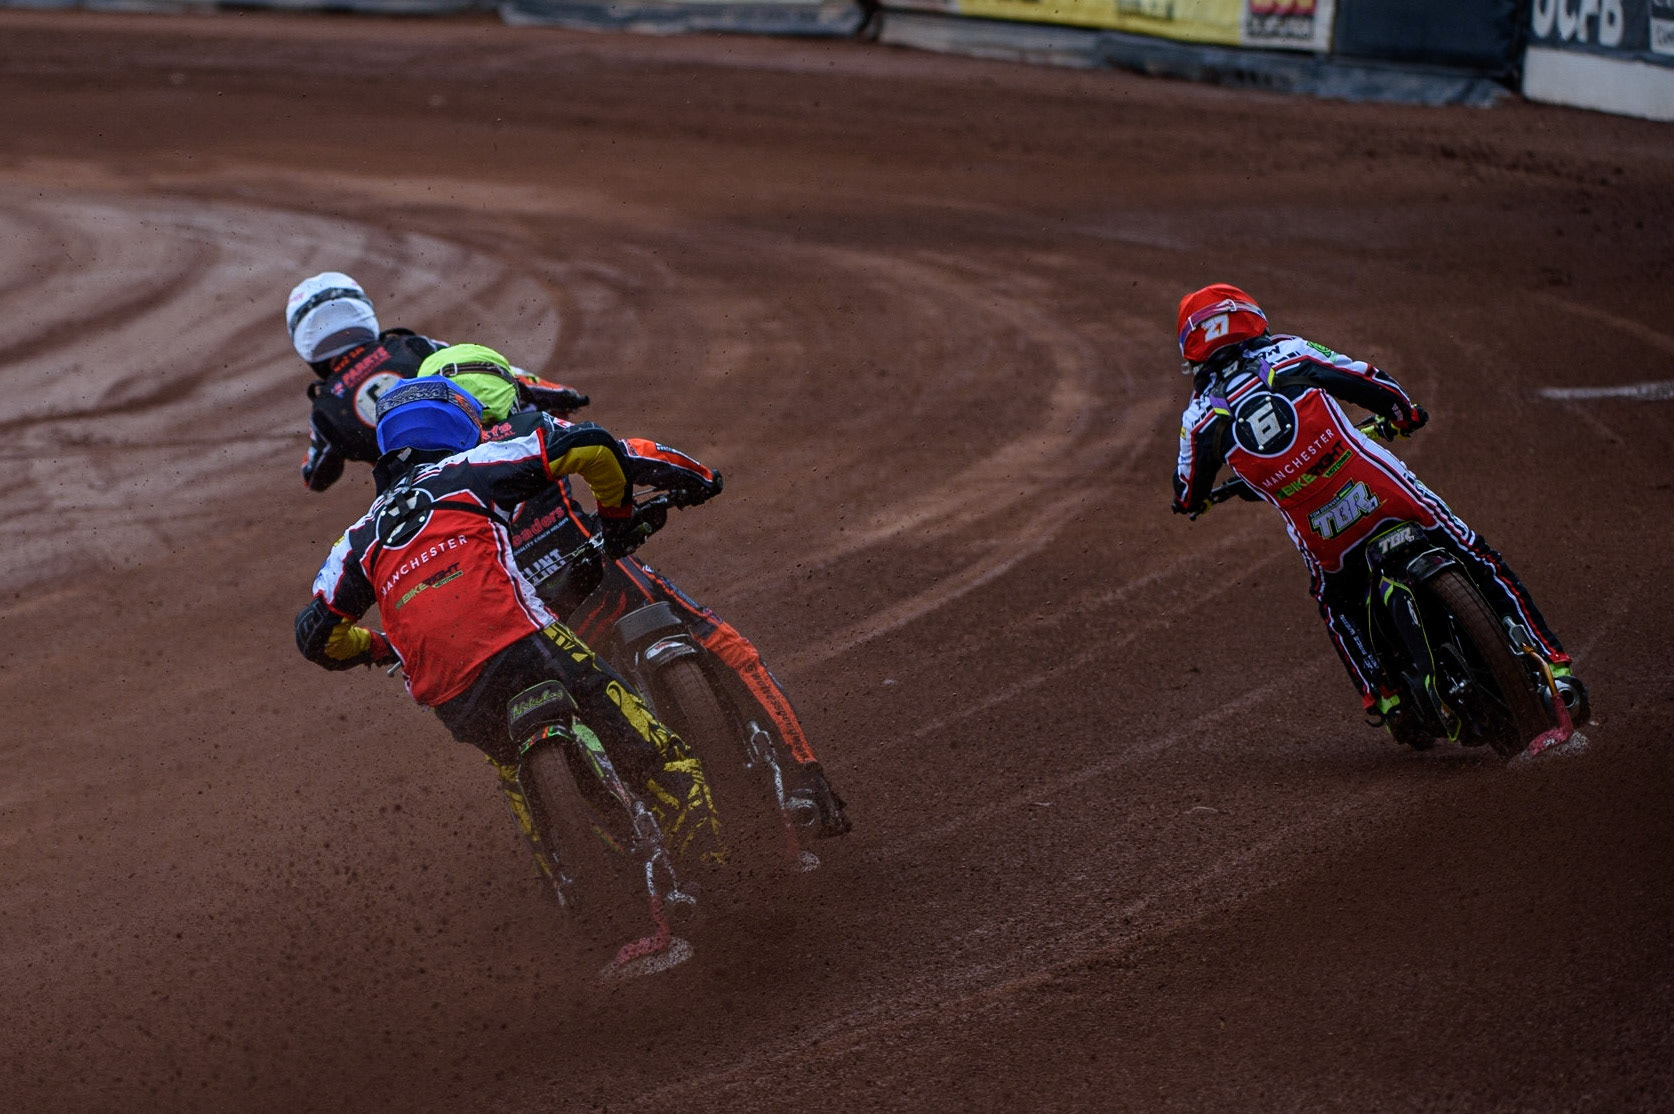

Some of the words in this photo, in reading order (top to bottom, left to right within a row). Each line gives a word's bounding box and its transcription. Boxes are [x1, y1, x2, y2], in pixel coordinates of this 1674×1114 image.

[1201, 313, 1229, 342] 27
[1246, 402, 1281, 445] 6
[1262, 428, 1334, 488] MANCHESTER
[1312, 481, 1368, 537] TBR
[521, 548, 566, 585] LINT
